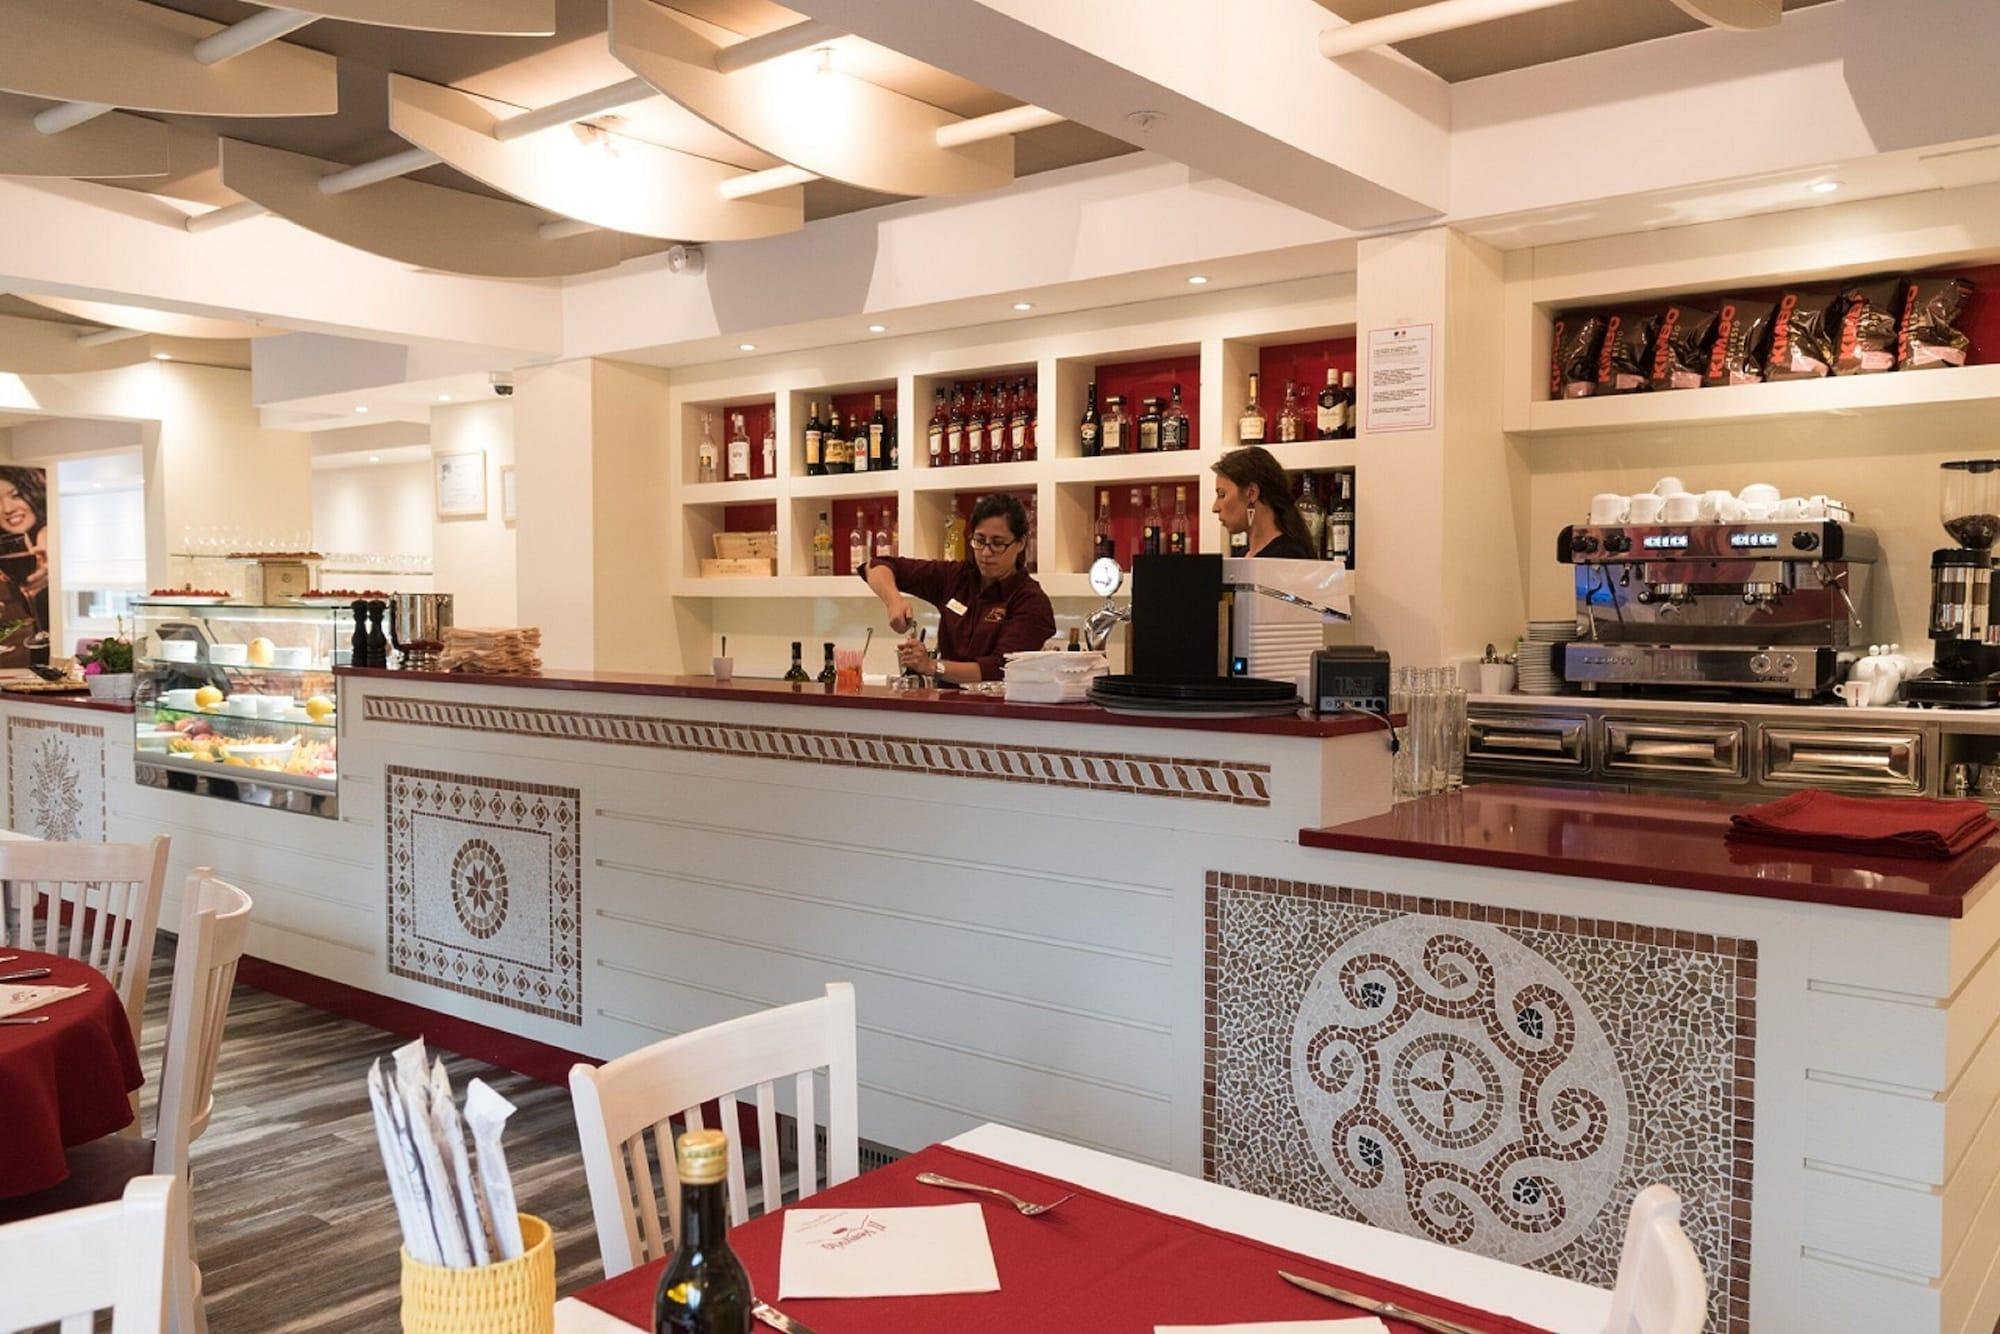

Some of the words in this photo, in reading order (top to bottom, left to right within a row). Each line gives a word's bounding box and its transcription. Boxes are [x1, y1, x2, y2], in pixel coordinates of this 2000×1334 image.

[1598, 316, 1621, 383] KIMBO
[1652, 307, 1680, 379] KIMBO
[1709, 304, 1736, 379] KIMBO
[1769, 293, 1798, 364] KIMBO
[1839, 293, 1863, 361] KIMB
